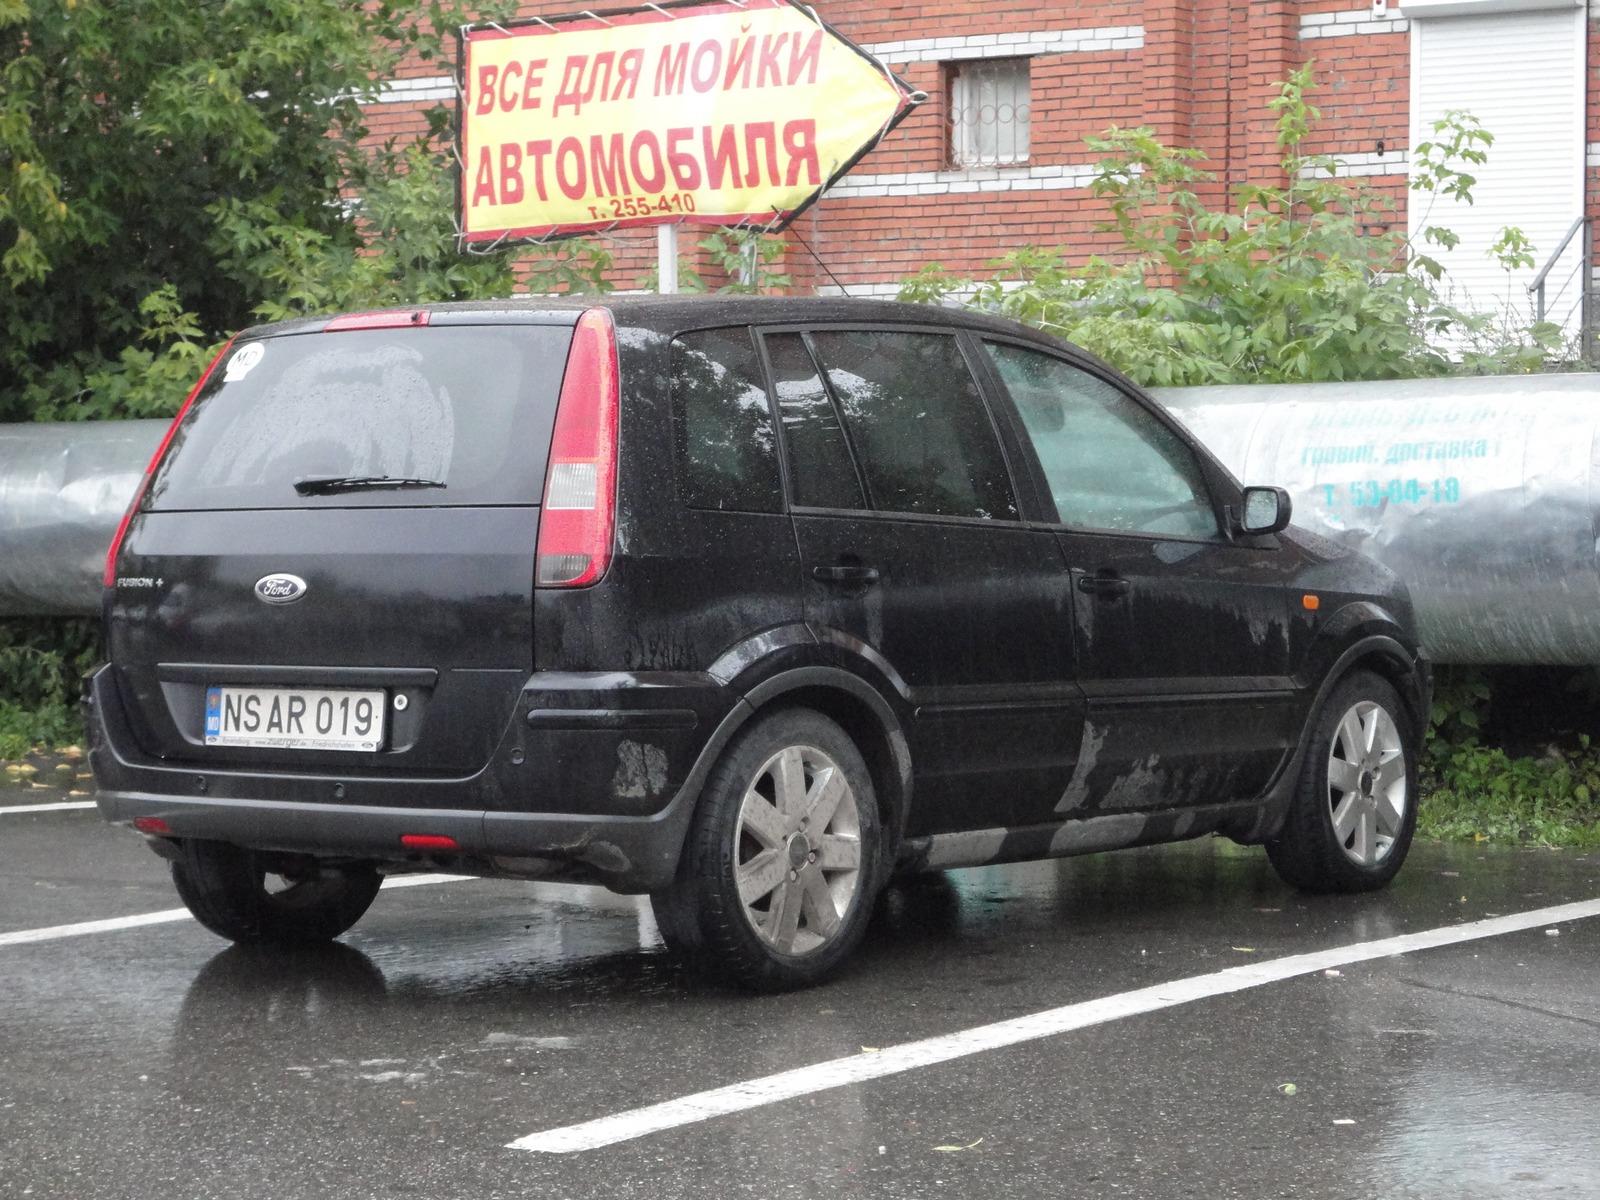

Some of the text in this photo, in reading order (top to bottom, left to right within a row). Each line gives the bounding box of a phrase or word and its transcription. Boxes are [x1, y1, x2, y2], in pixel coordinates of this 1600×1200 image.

[475, 23, 824, 118] ВСЕ ДЛЯ МОЙКИ
[472, 119, 821, 206] АВТОМОБИЛЯ
[612, 193, 696, 219] 255-410
[117, 577, 153, 588] FUSION
[263, 579, 291, 596] Ford
[315, 696, 373, 736] 019
